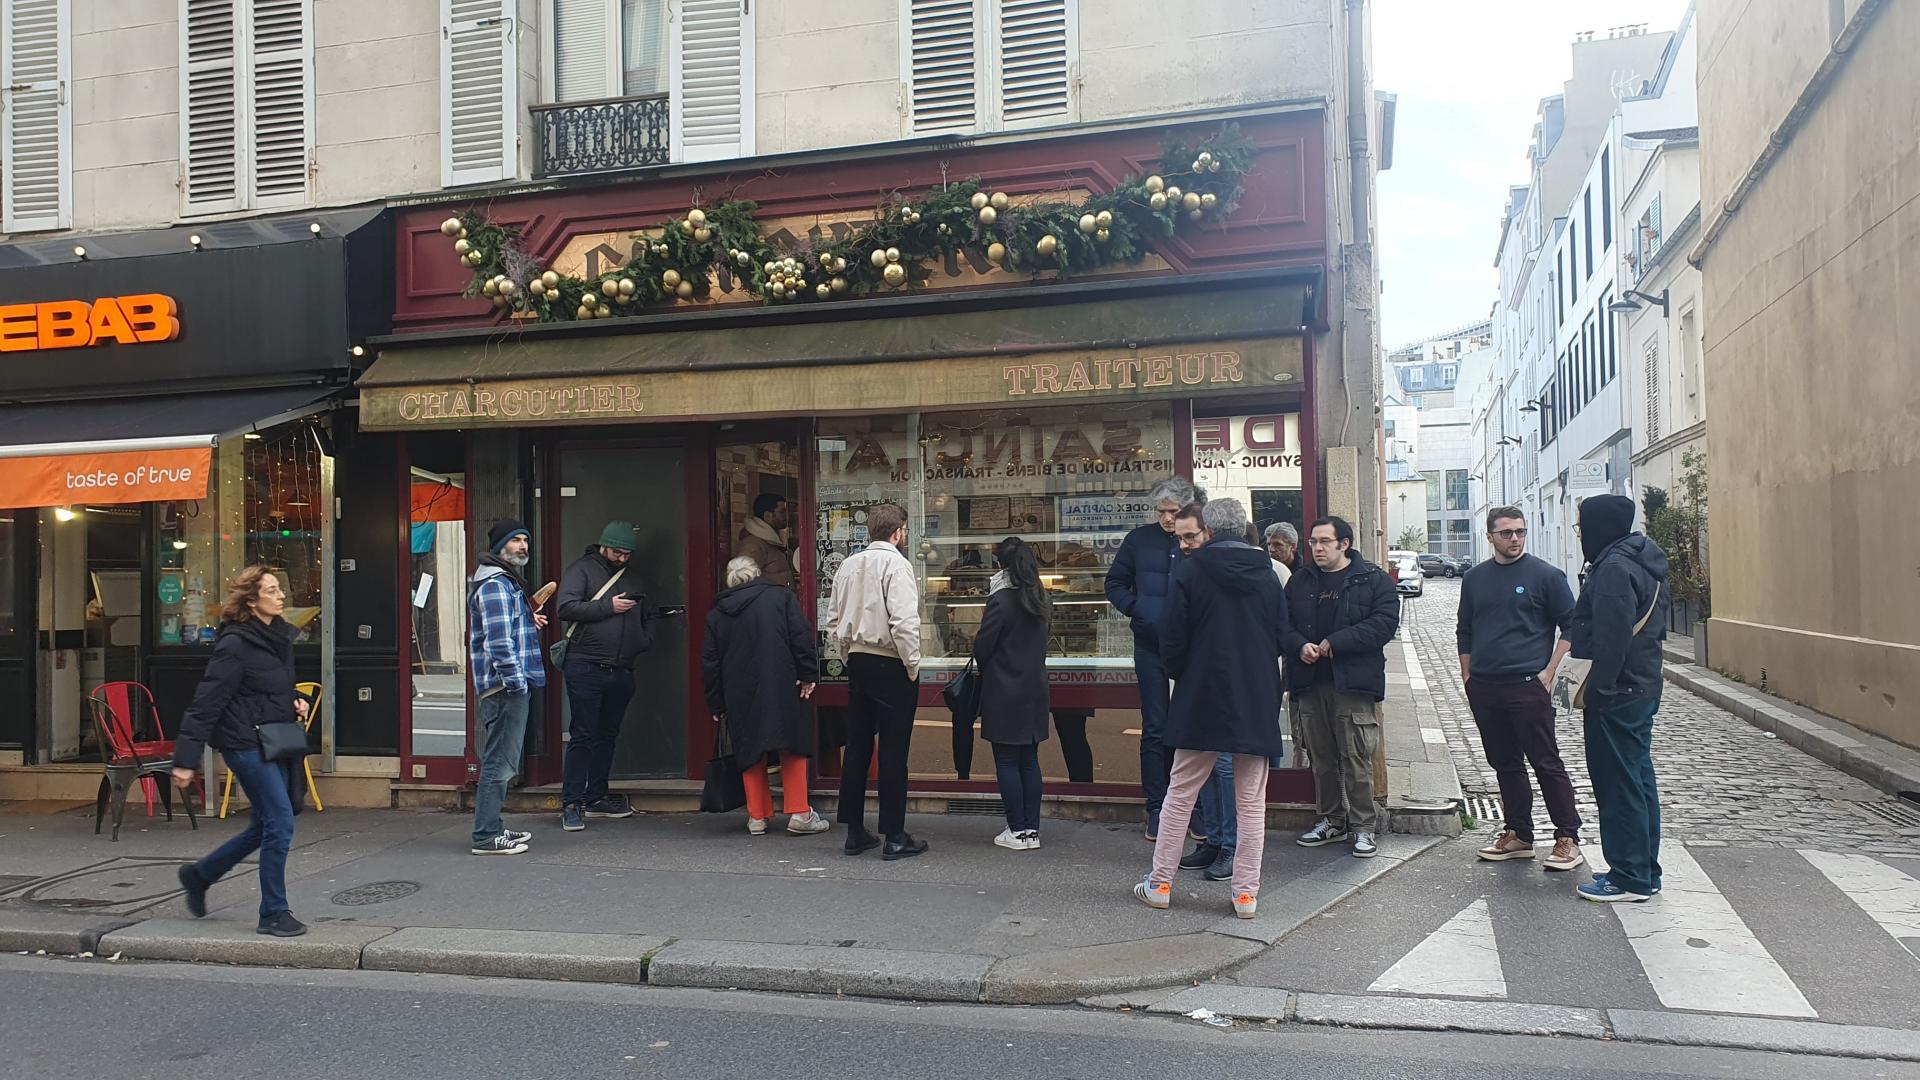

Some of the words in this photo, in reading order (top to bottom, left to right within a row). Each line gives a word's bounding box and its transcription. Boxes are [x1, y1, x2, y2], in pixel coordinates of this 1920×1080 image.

[1003, 351, 1244, 395] TRAITEUR
[399, 385, 644, 421] CHARCUTIER
[66, 471, 119, 489] taste
[124, 466, 146, 485] of
[149, 466, 192, 484] true
